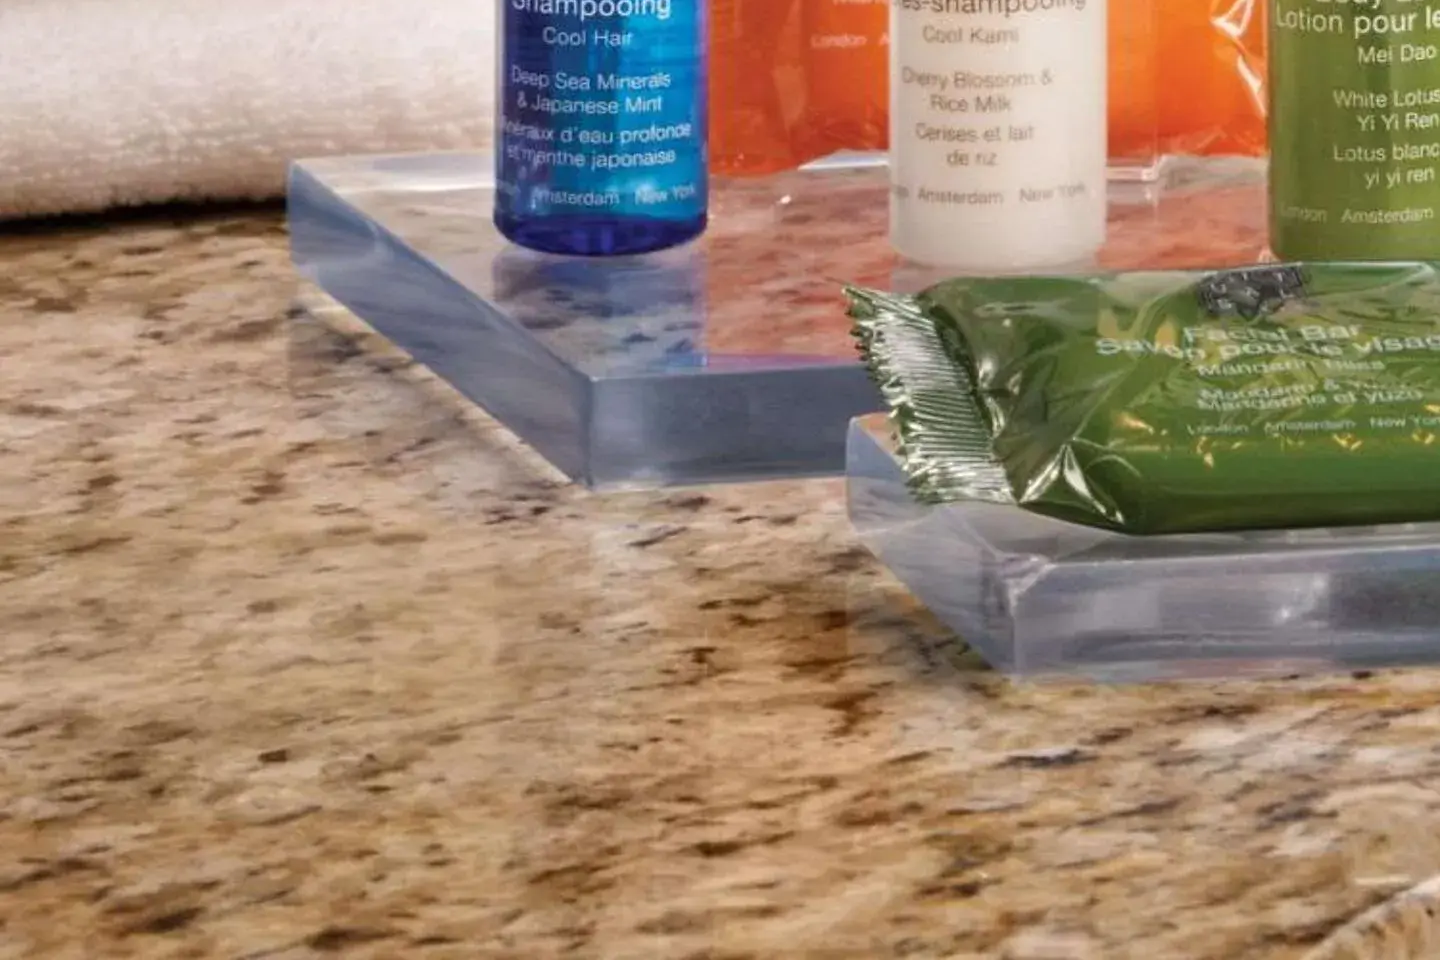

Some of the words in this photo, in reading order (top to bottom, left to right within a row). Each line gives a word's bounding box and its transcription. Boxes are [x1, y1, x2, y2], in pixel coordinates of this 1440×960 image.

[1275, 2, 1344, 34] Lotion
[1353, 11, 1419, 39] pour
[542, 26, 587, 46] Cool
[594, 28, 634, 47] Hair
[1357, 44, 1394, 64] Mei
[1399, 43, 1438, 63] Dao
[511, 65, 550, 88] Deep
[554, 72, 591, 90] Sea
[597, 72, 672, 91] Minerals
[517, 91, 528, 108] &
[530, 94, 620, 115] Japanese
[624, 96, 663, 113] Mint
[930, 93, 969, 113] Rice
[974, 94, 1014, 113] Milk
[1332, 88, 1388, 109] White
[1356, 114, 1376, 132] Yi
[1380, 113, 1400, 132] Yi
[1404, 111, 1440, 130] Ren
[590, 148, 677, 171] japonaise
[946, 148, 970, 166] de
[1332, 144, 1387, 163] Lotus
[1391, 141, 1440, 161] blanc
[1364, 168, 1381, 190] yi
[1385, 167, 1402, 189] yi
[1406, 166, 1436, 185] ren
[1339, 205, 1435, 225] Amsterdam
[1300, 324, 1363, 340] Bar
[1094, 337, 1207, 363] Savon
[1369, 415, 1407, 429] New
